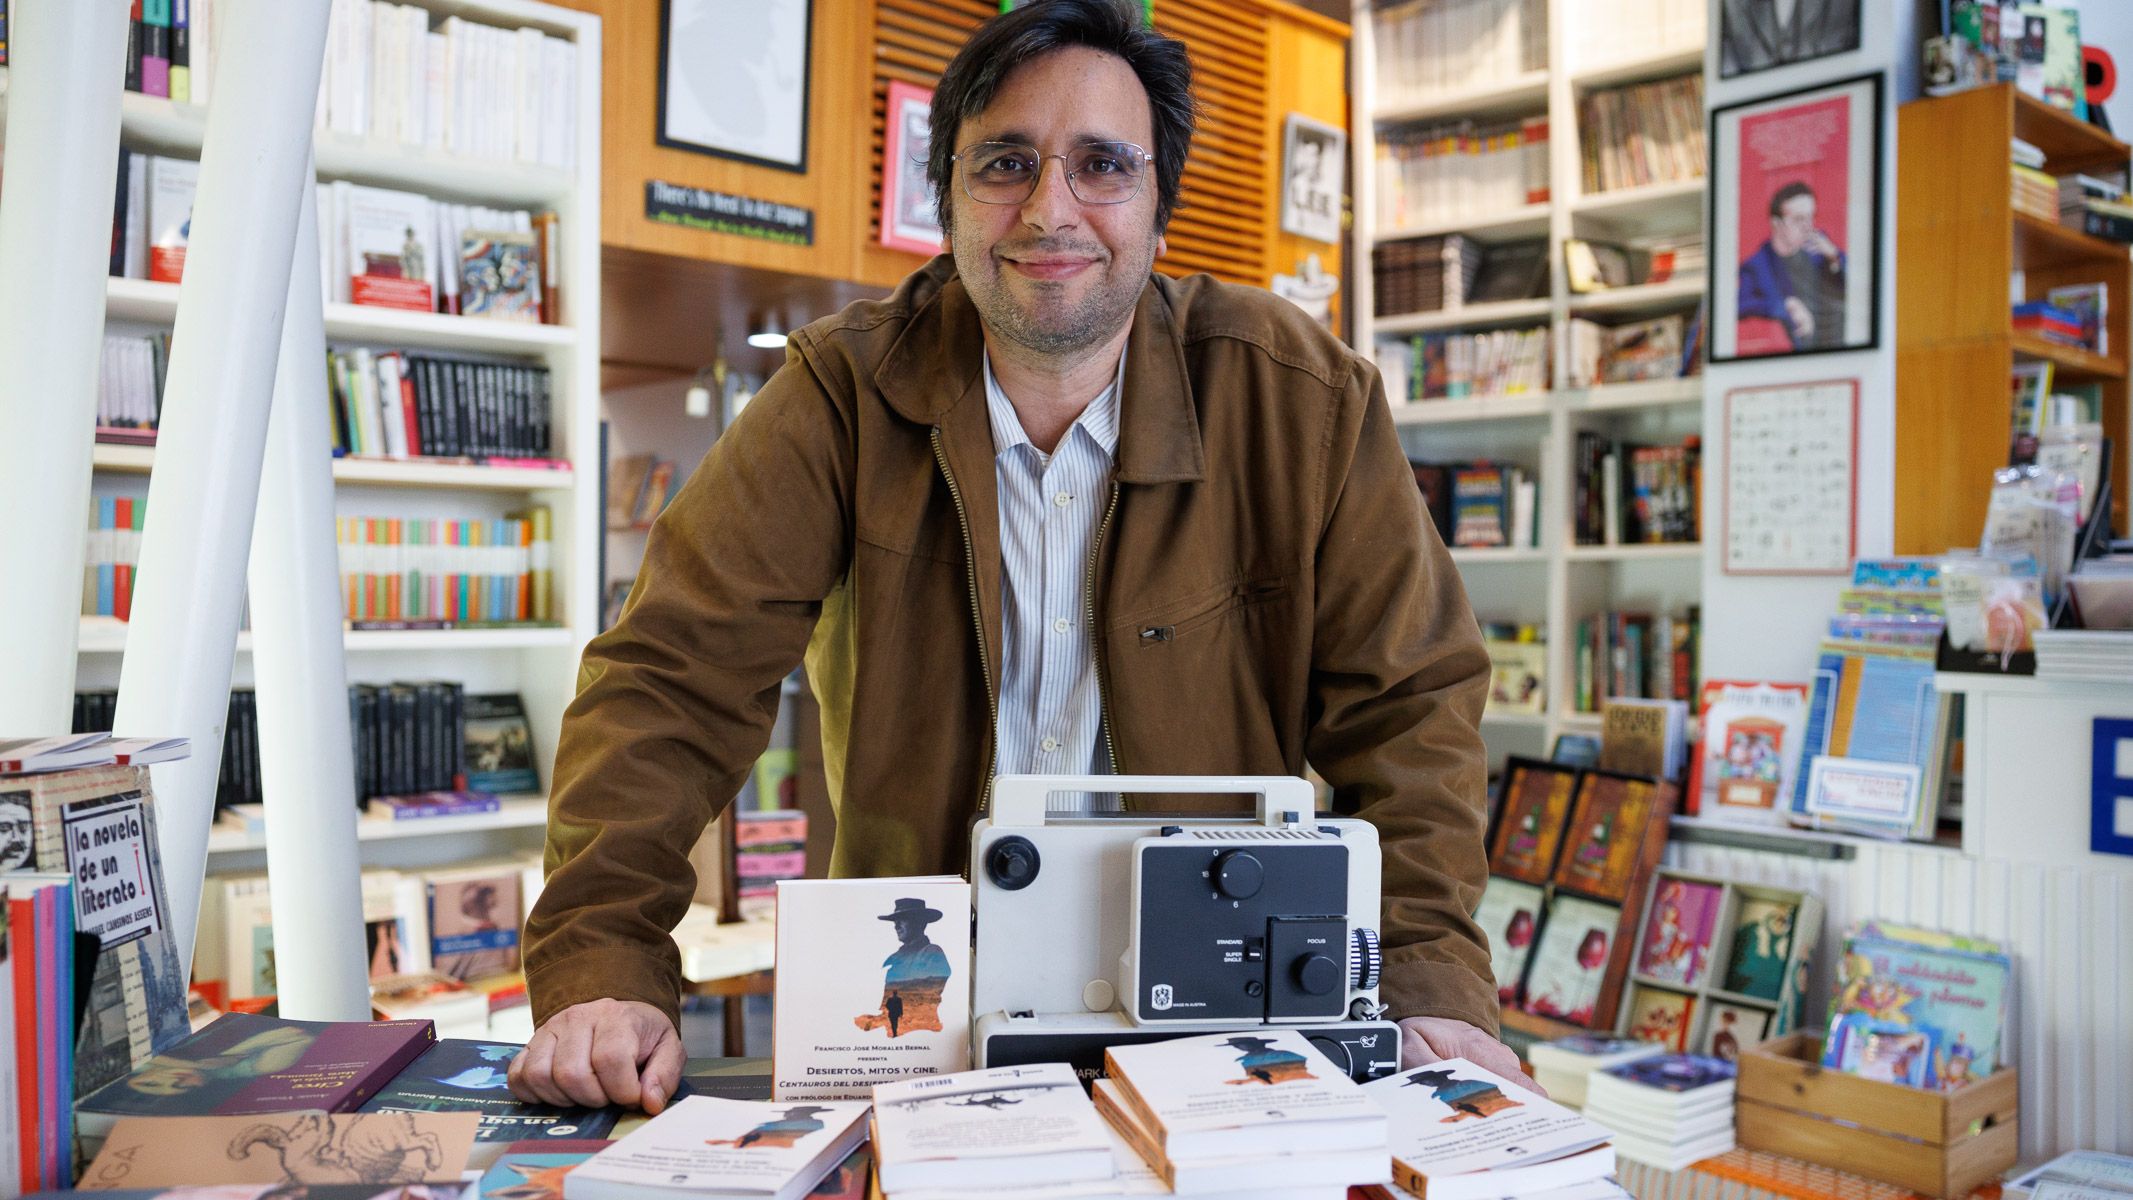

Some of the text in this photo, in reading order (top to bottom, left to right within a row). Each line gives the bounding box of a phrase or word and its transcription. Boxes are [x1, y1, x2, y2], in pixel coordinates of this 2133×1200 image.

[74, 815, 140, 852] la novela
[79, 855, 119, 883] de un
[81, 879, 136, 916] literato
[1233, 900, 1239, 909] 6
[106, 912, 134, 932] CANSINOS
[806, 1066, 866, 1076] DESIERTOS,
[912, 1066, 938, 1074] CINE:
[1074, 1068, 1101, 1079] ARK
[292, 1080, 345, 1090] Circe
[779, 1080, 832, 1088] CENTAUROS
